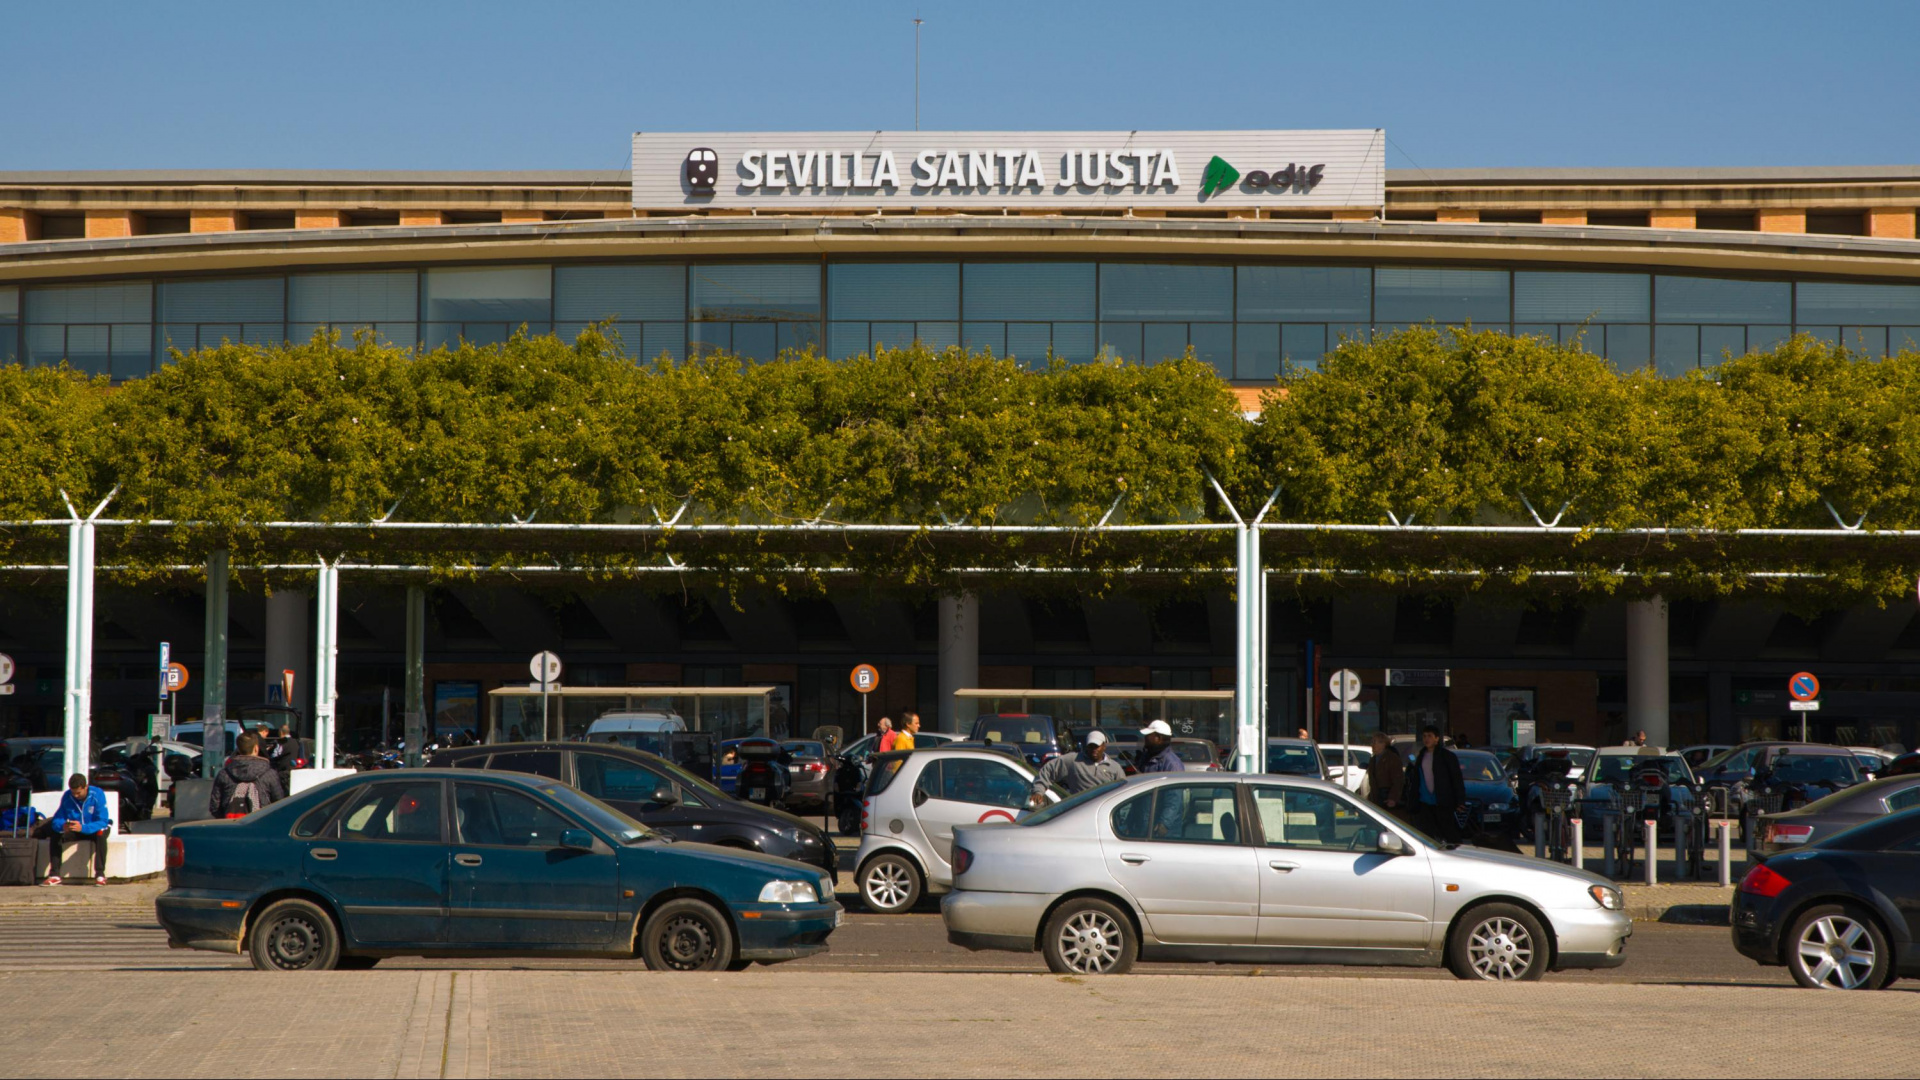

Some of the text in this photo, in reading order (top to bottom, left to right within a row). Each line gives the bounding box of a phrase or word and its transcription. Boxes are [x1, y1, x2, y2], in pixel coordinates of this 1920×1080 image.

[742, 149, 1181, 187] SEVILLA SANTA JUSTA
[1245, 163, 1326, 188] adif
